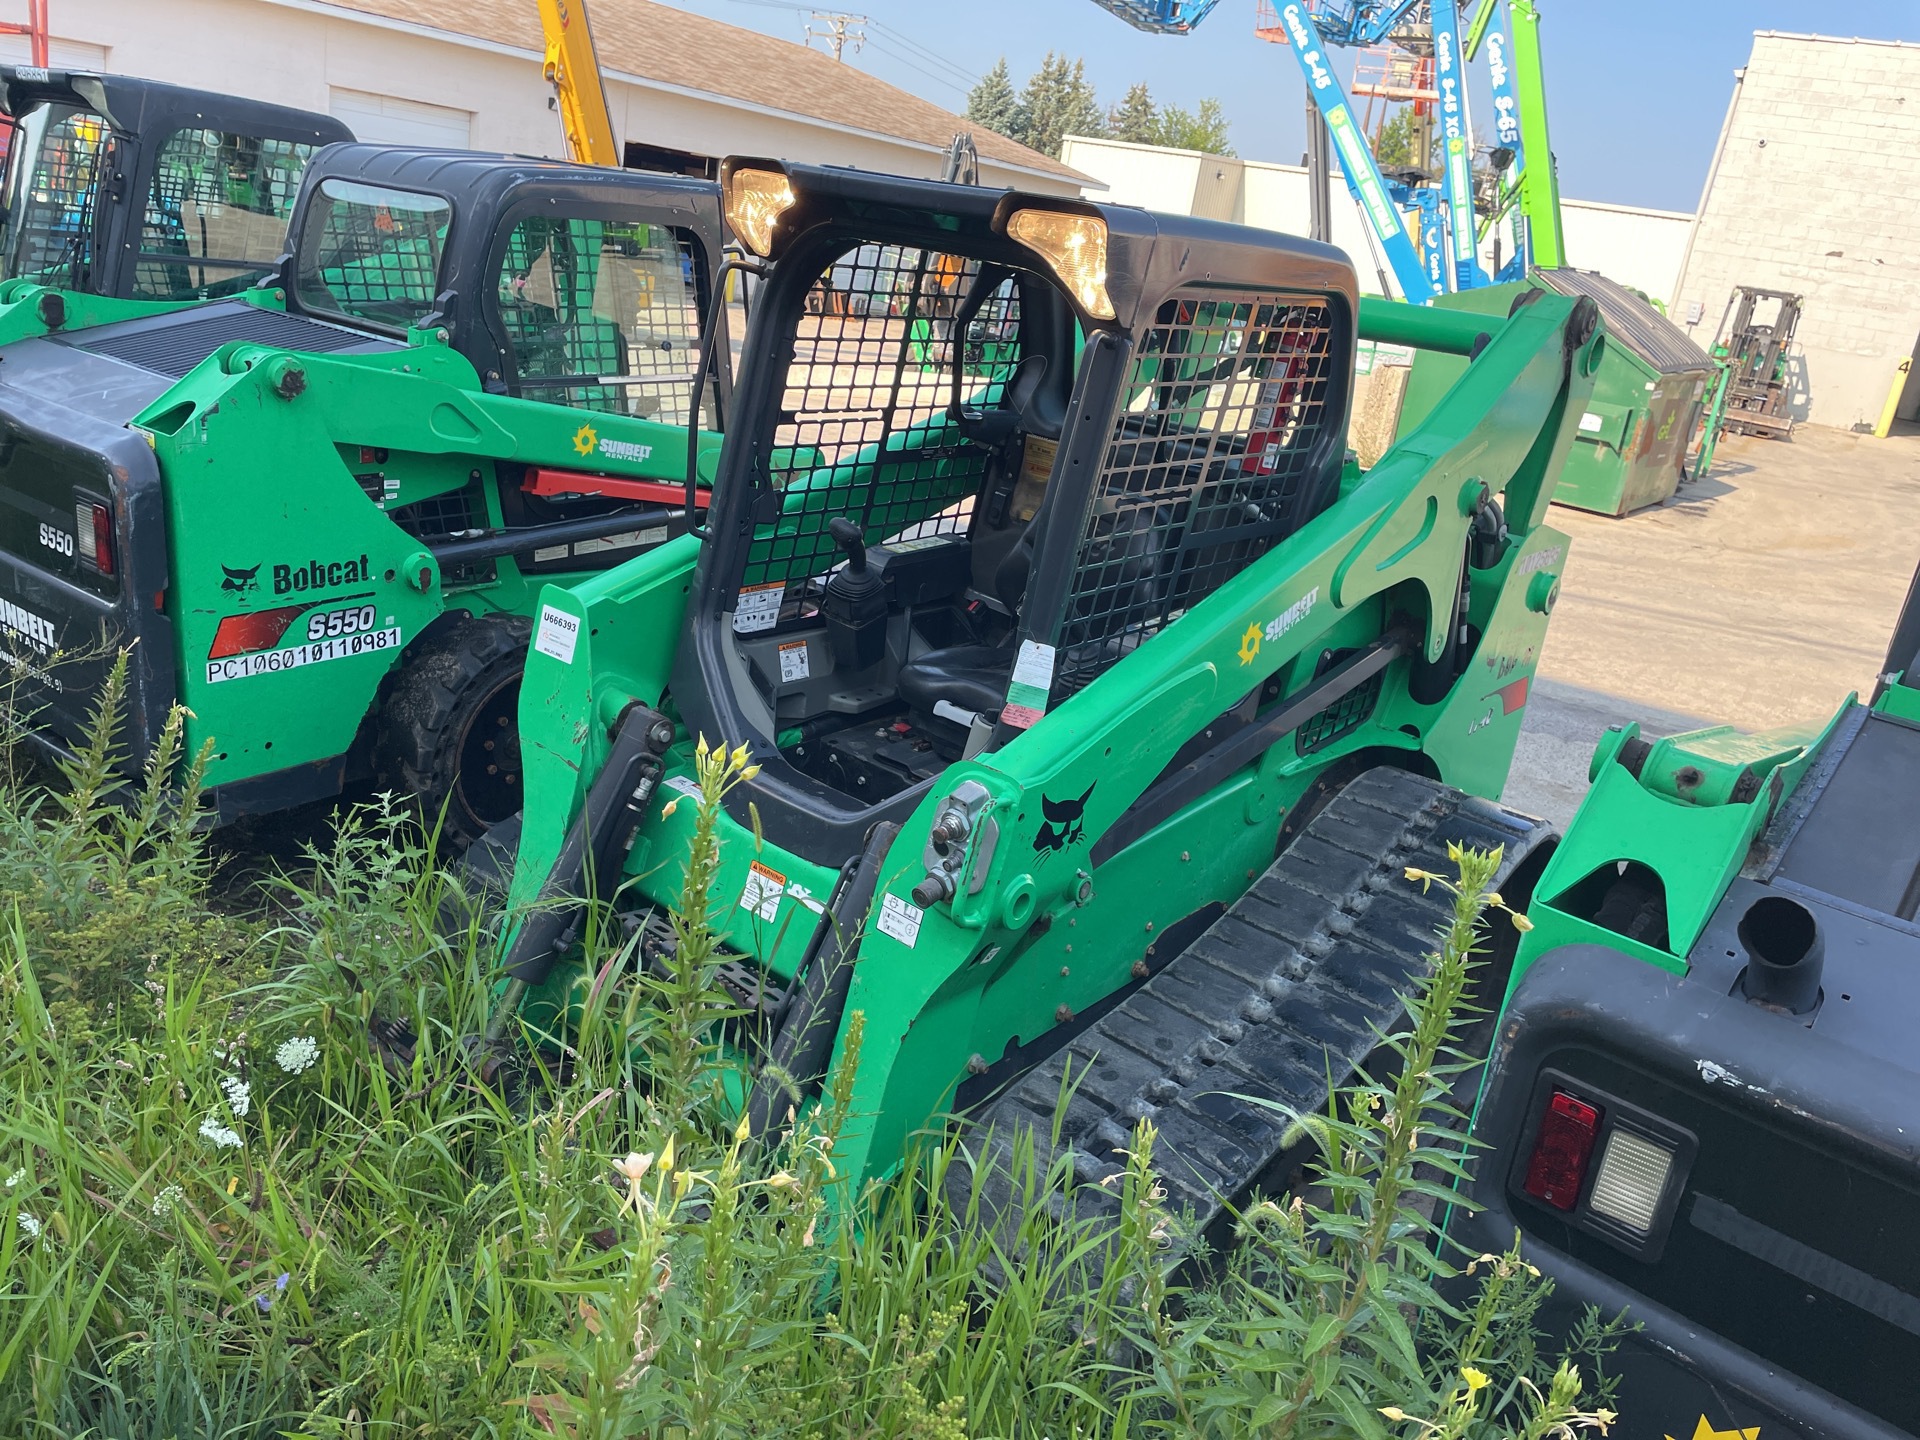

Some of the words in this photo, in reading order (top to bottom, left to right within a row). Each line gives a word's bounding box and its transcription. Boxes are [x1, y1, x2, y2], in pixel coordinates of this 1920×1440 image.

[1283, 4, 1309, 51] Genie
[1303, 50, 1332, 90] S-45
[1486, 32, 1508, 91] Genie
[1494, 96, 1519, 144] S-65
[1898, 361, 1910, 374] 4
[599, 438, 653, 459] SUNBELT
[605, 451, 644, 463] RENTALS
[39, 522, 74, 557] S550
[273, 553, 370, 595] Bobcat
[307, 604, 377, 642] S550
[543, 611, 577, 633] U666393
[1265, 585, 1320, 642] SUNBELT
[1272, 608, 1311, 642] RENTALS
[758, 865, 785, 884] WARNING
